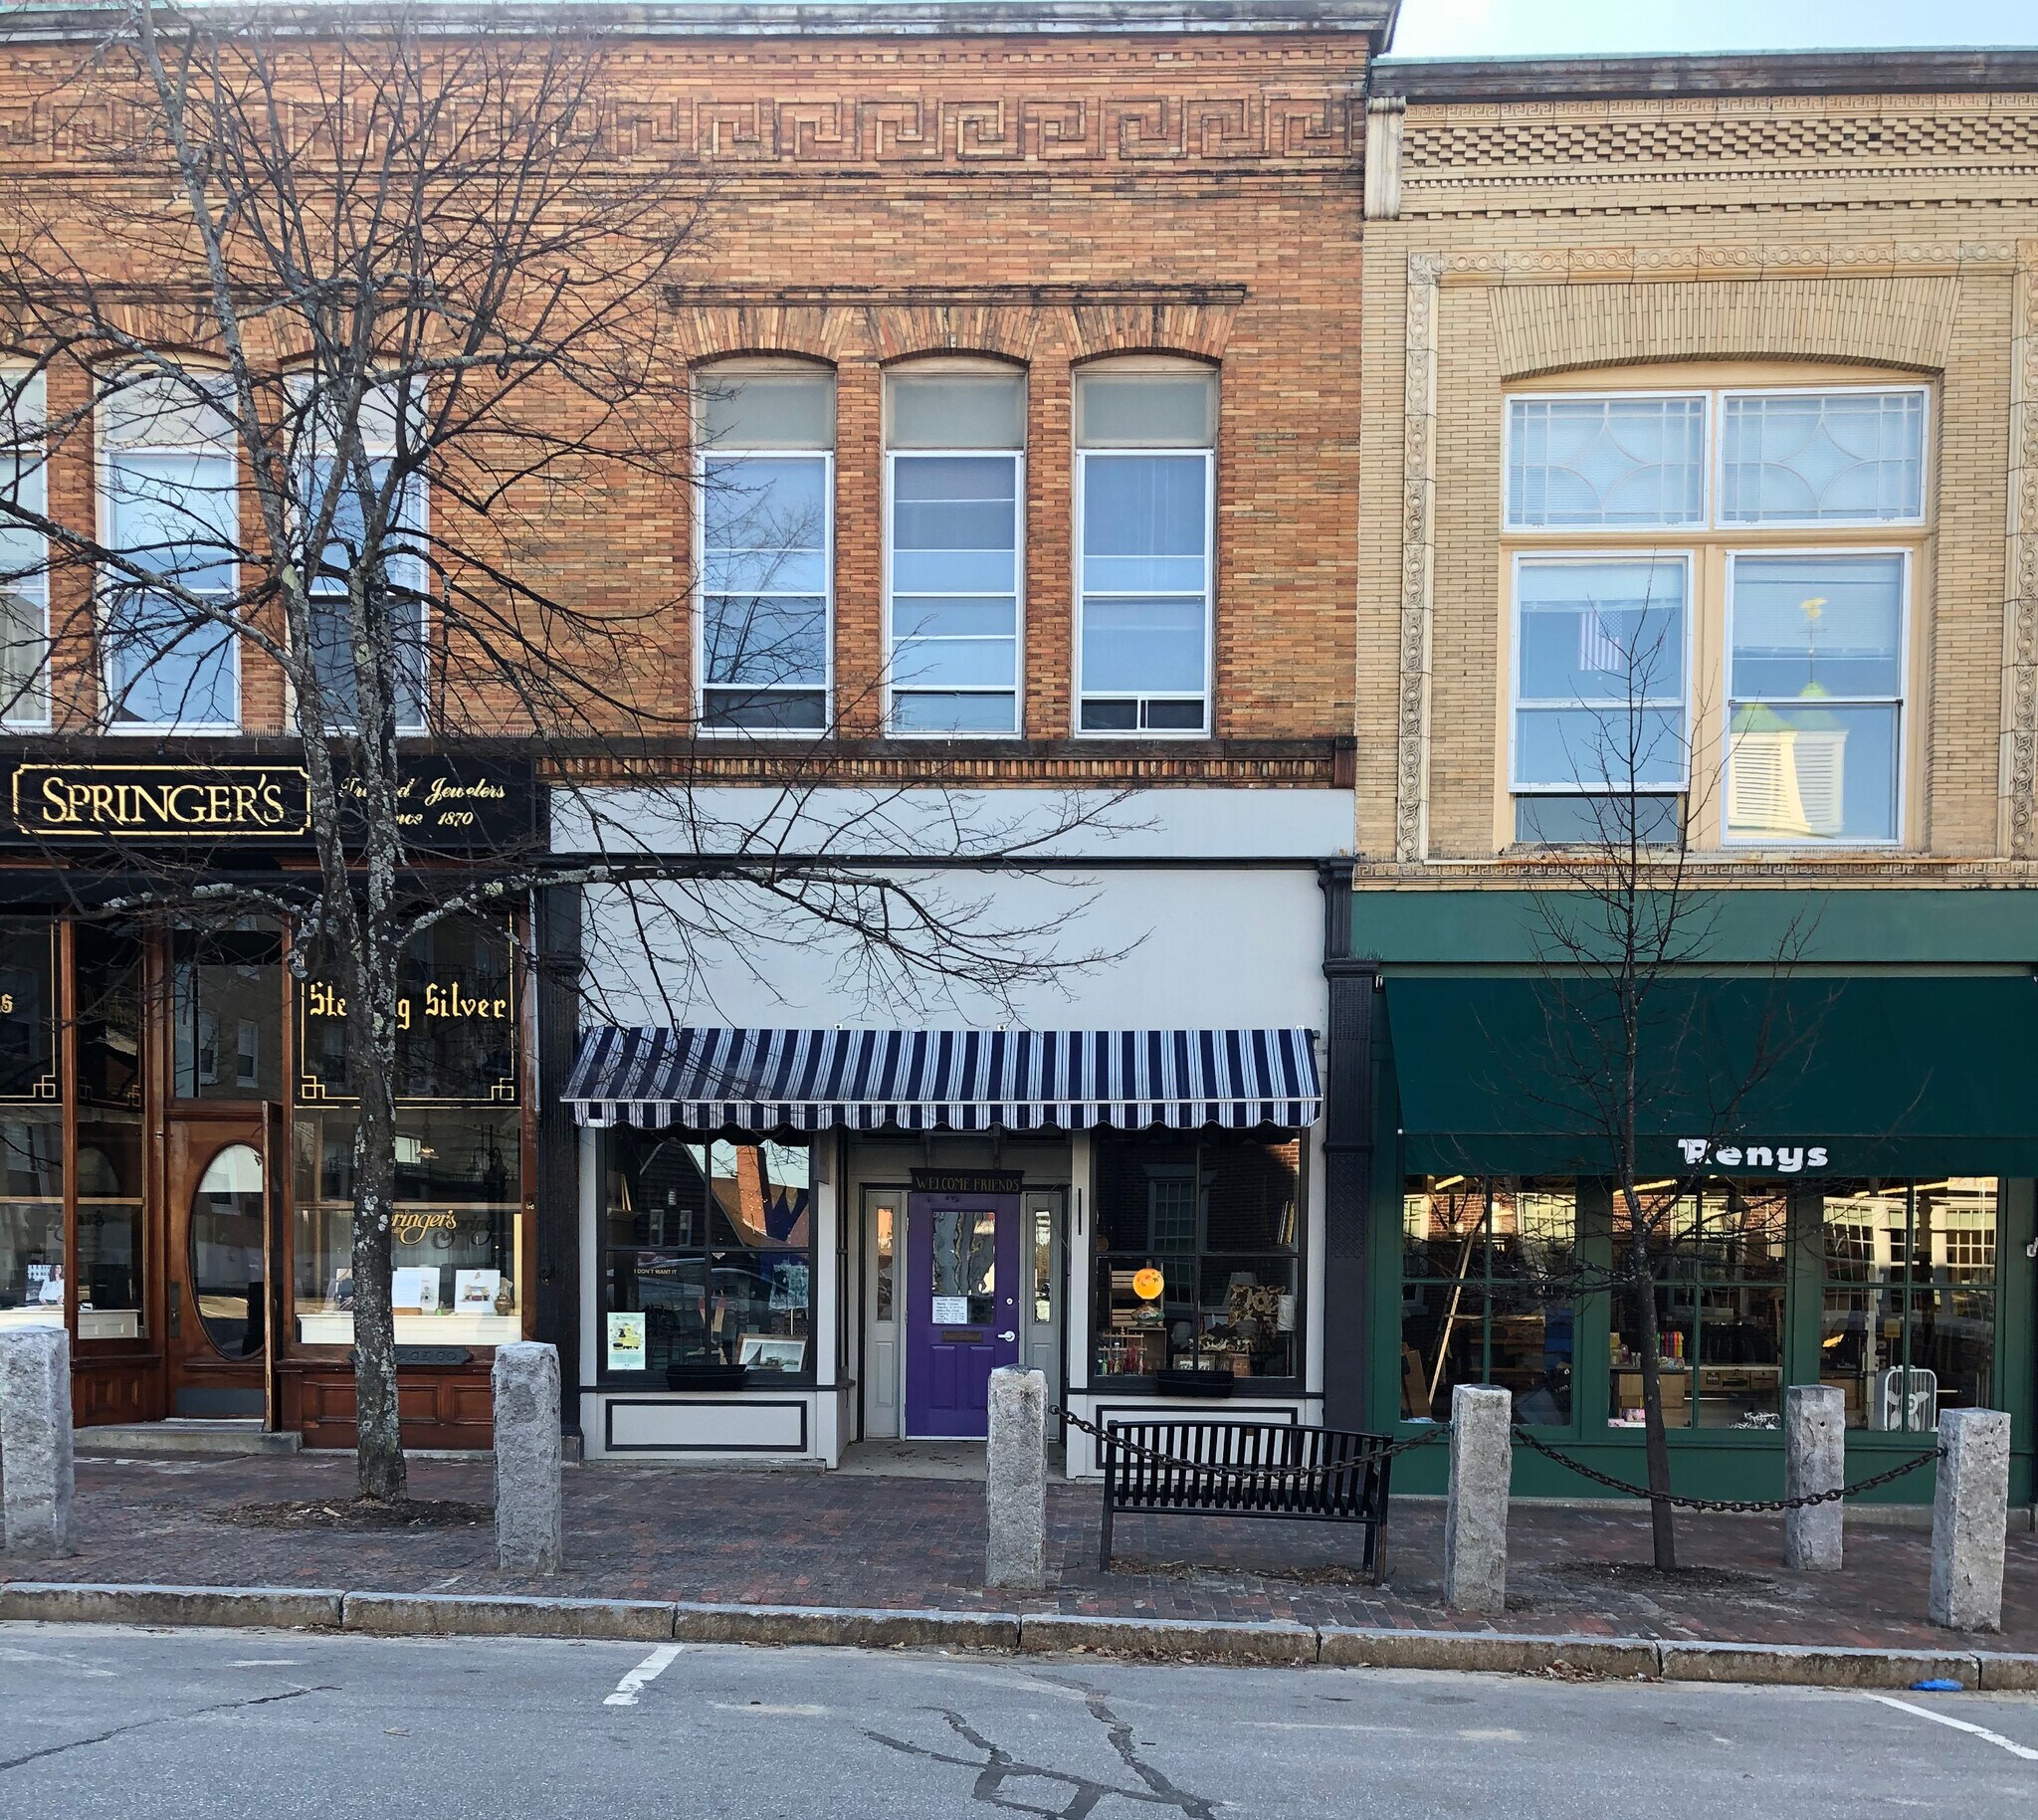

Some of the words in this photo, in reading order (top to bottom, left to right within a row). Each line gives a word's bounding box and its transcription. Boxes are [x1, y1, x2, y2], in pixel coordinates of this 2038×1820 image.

[42, 773, 285, 827] SPRINGER'S
[337, 777, 416, 798] Trud
[424, 777, 506, 807] Jewelers
[437, 811, 474, 827] 1870
[309, 981, 411, 1030] Steg
[425, 981, 507, 1019] Silver
[1677, 1138, 1829, 1172] Renys
[916, 1177, 970, 1191] WELCOME
[973, 1178, 1020, 1192] FRIENDS
[391, 1210, 457, 1245] ringer's
